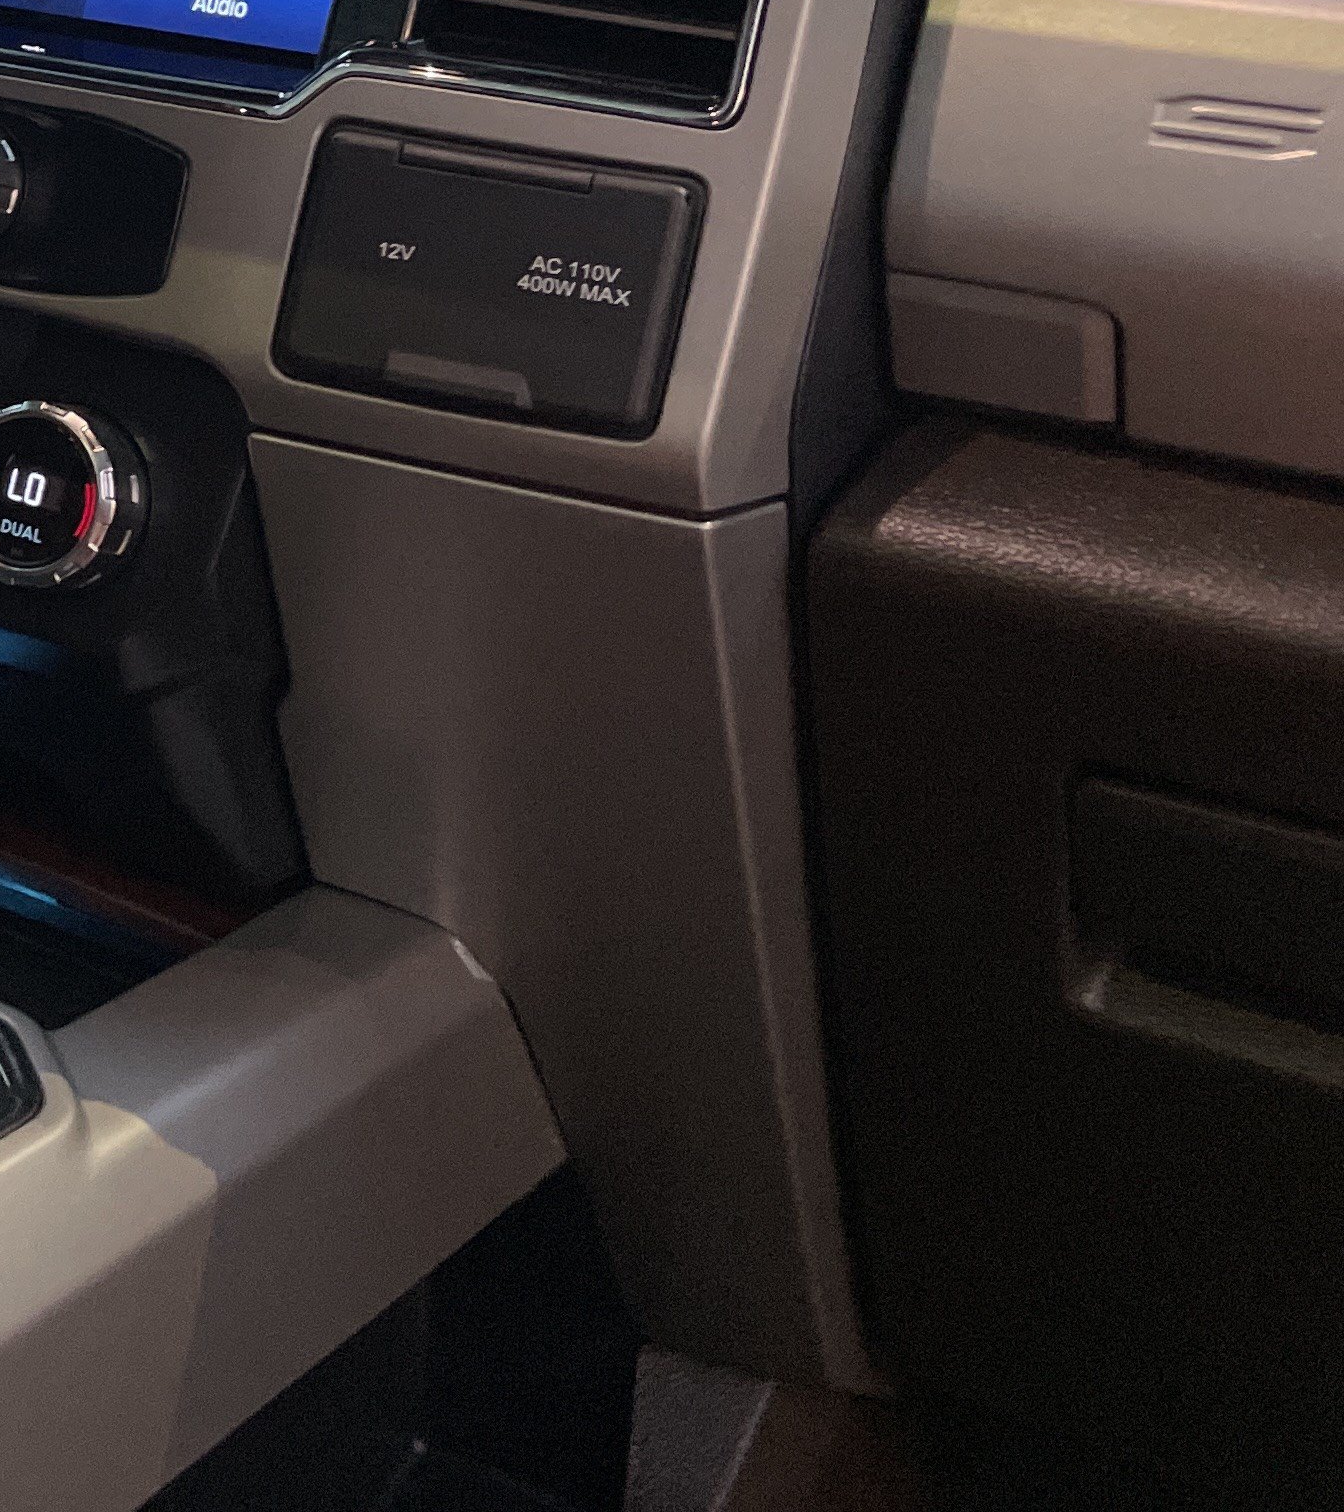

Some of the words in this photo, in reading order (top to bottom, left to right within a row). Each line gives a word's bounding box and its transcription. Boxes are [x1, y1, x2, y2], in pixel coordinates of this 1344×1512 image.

[379, 241, 416, 261] 12V
[529, 256, 562, 276] AC
[568, 261, 622, 284] 110V
[516, 274, 576, 298] 400W
[580, 284, 632, 307] MAX
[7, 468, 46, 507] LO
[0, 518, 42, 544] DUAL
